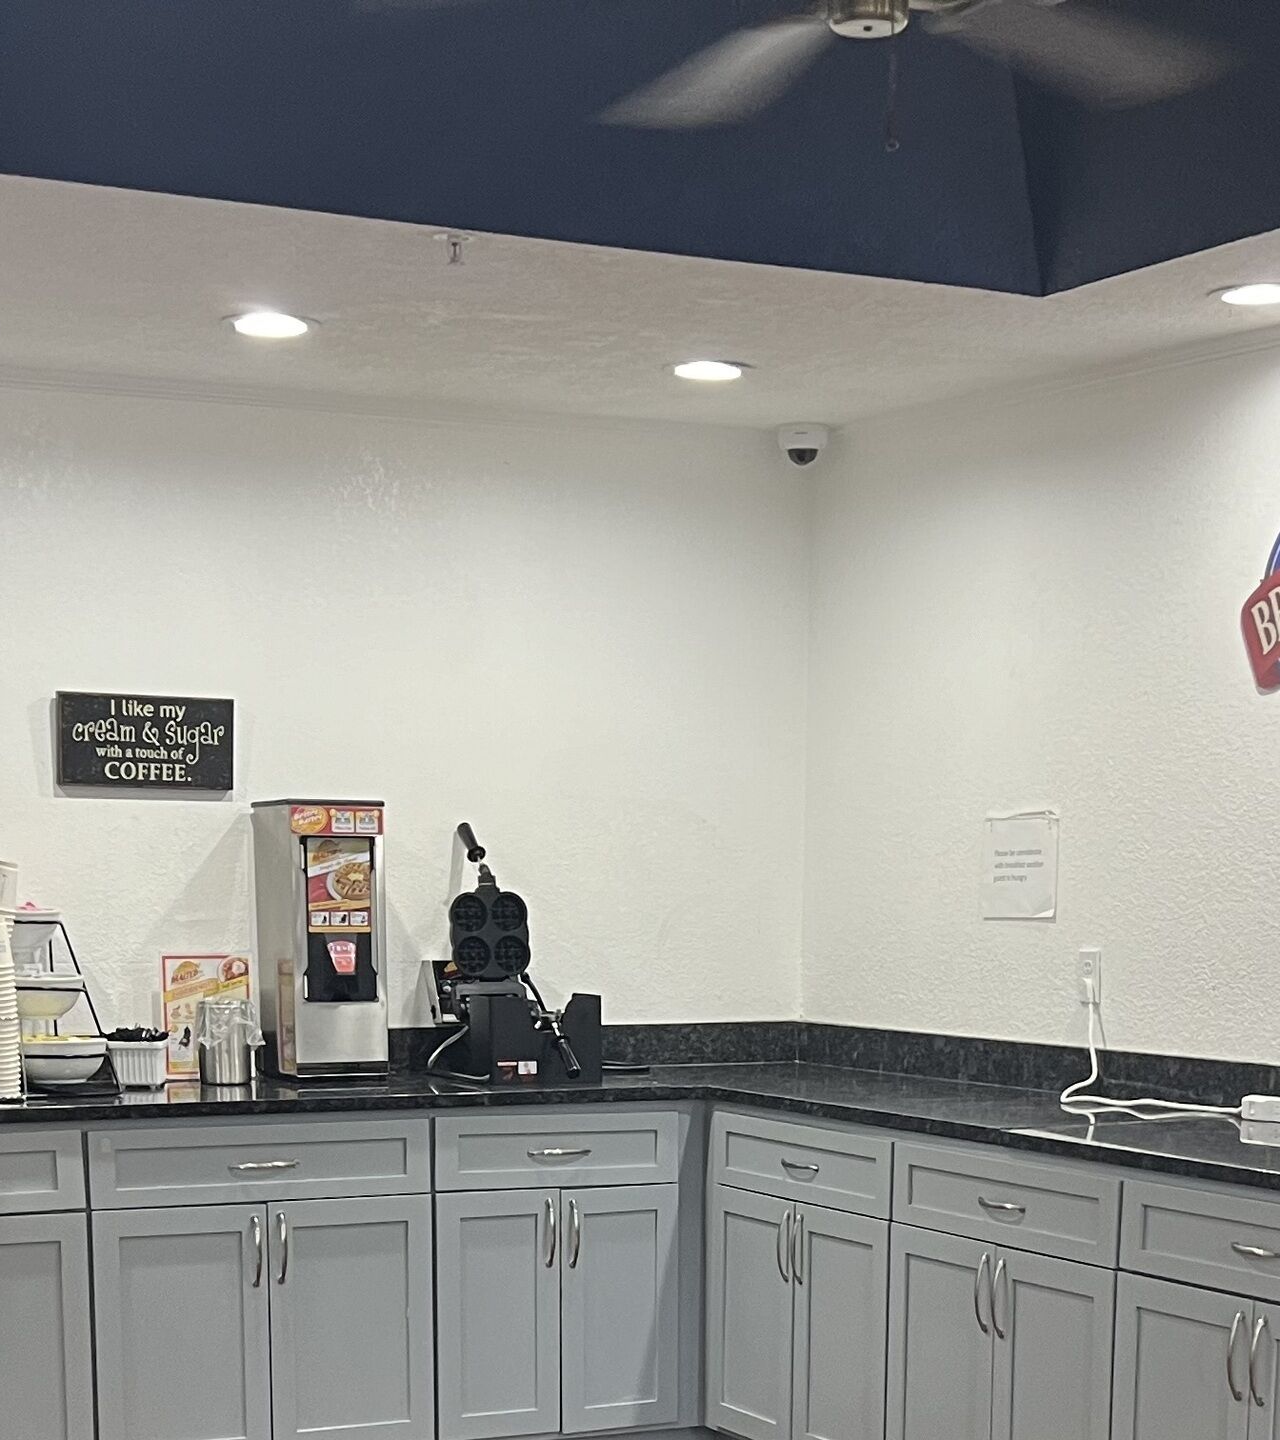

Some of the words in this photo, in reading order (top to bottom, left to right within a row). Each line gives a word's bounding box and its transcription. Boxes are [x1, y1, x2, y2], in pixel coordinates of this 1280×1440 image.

[110, 699, 116, 716] I
[122, 699, 154, 717] like
[159, 704, 186, 722] my
[72, 718, 136, 743] cream
[142, 721, 161, 746] &
[95, 745, 123, 758] with
[125, 749, 133, 758] a
[135, 747, 169, 759] touch
[170, 748, 185, 760] of
[104, 761, 192, 782] COFFEE.
